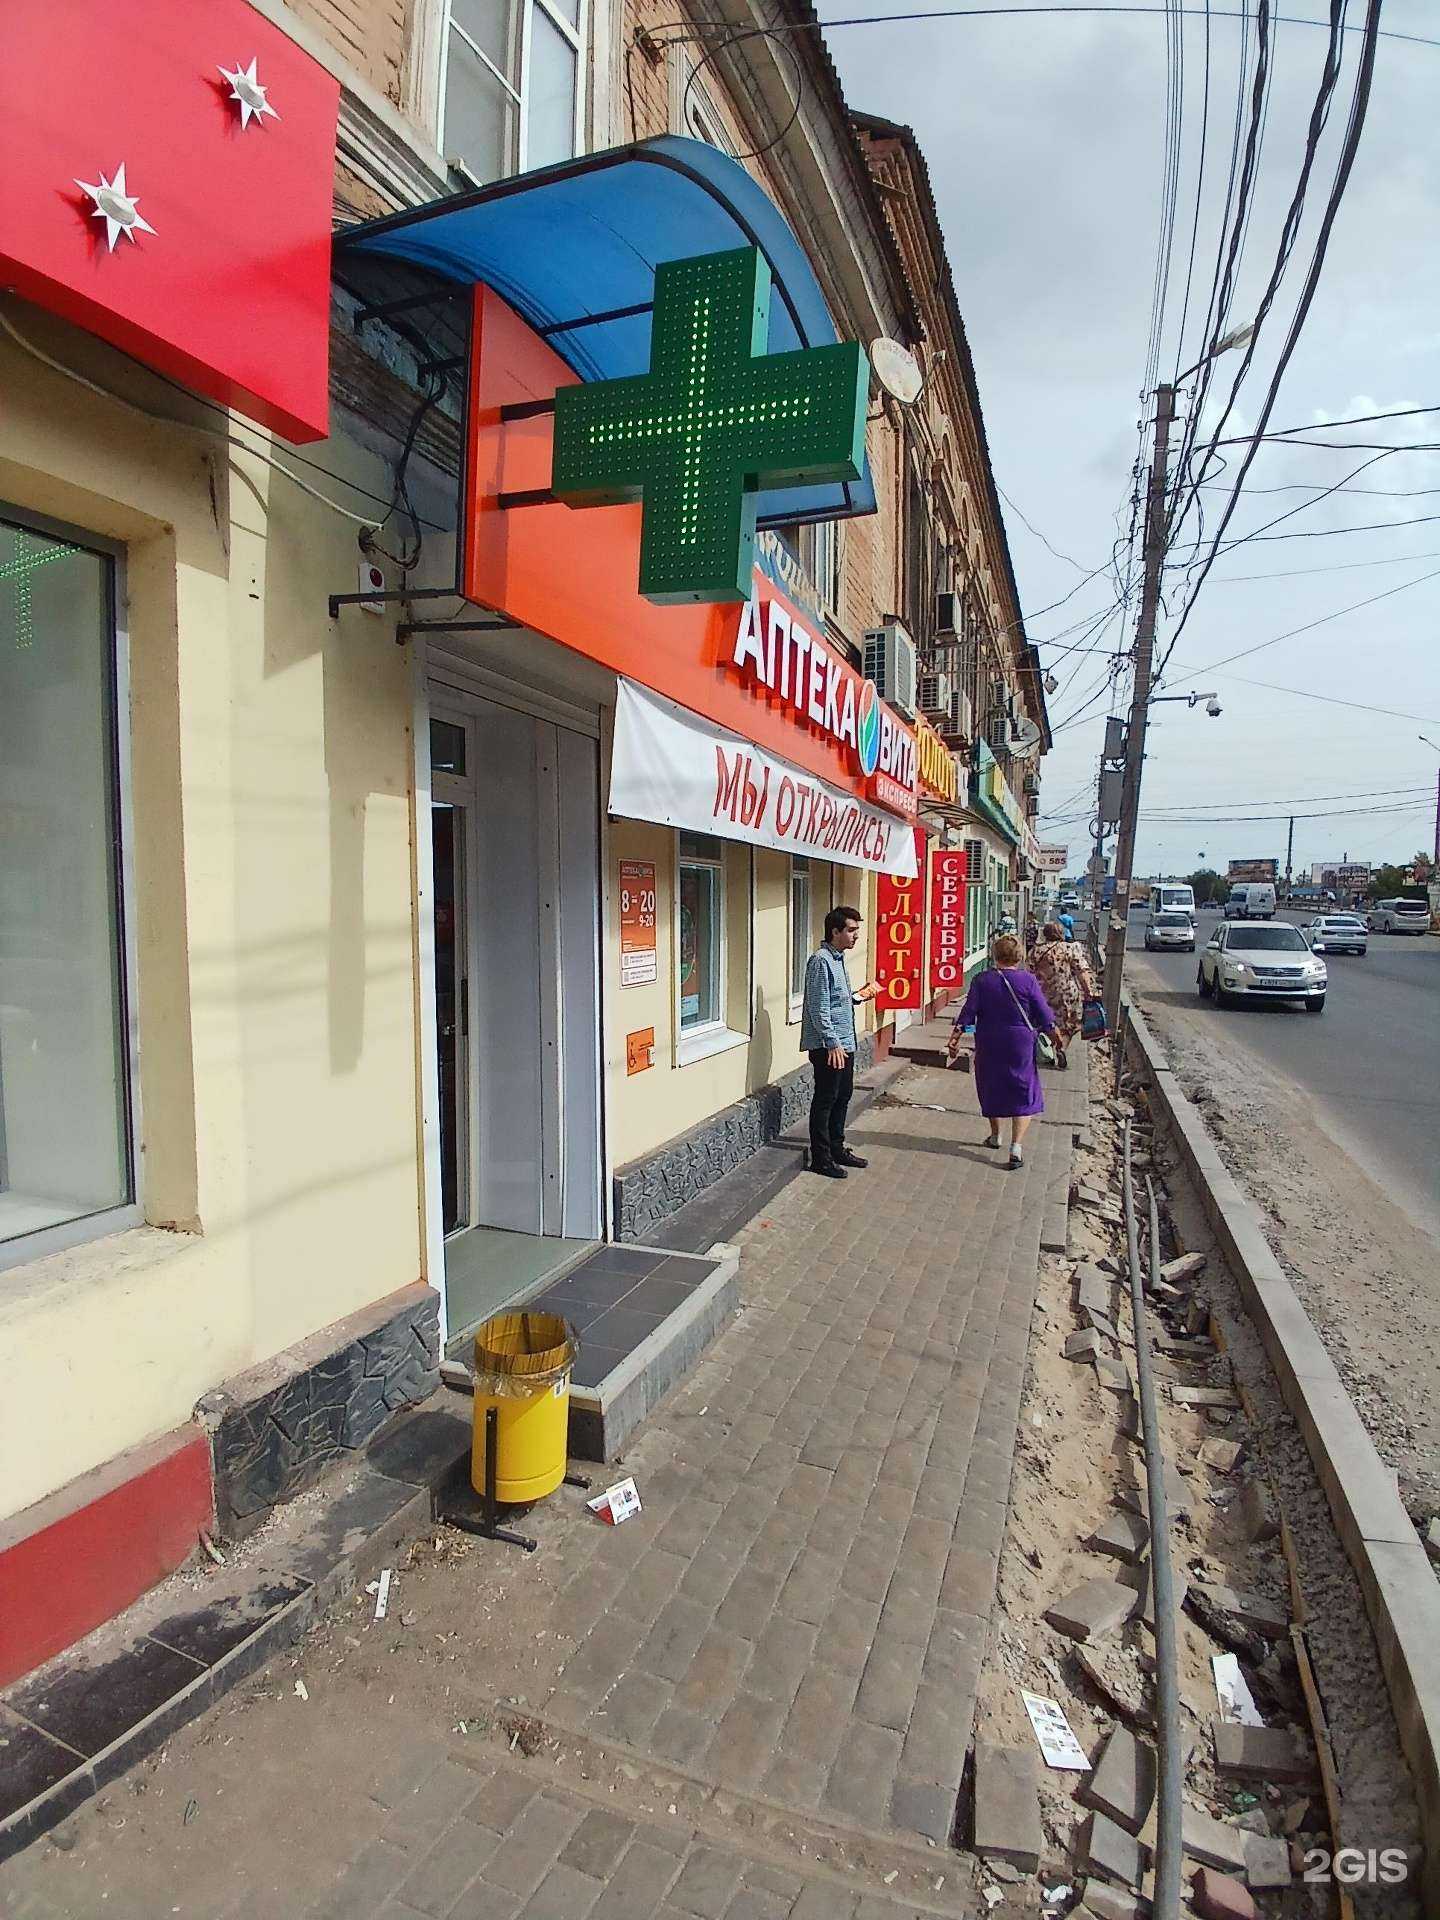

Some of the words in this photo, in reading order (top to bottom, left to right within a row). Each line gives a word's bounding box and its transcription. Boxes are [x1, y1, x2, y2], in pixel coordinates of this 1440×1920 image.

[734, 578, 857, 749] АПТЕКА
[879, 712, 916, 792] ВИТА
[713, 745, 770, 829] МЫ
[776, 775, 891, 864] ОТКРЫЛИСЬ!
[888, 873, 913, 1001] ОЛОТО
[938, 858, 958, 981] СЕРЕБРО
